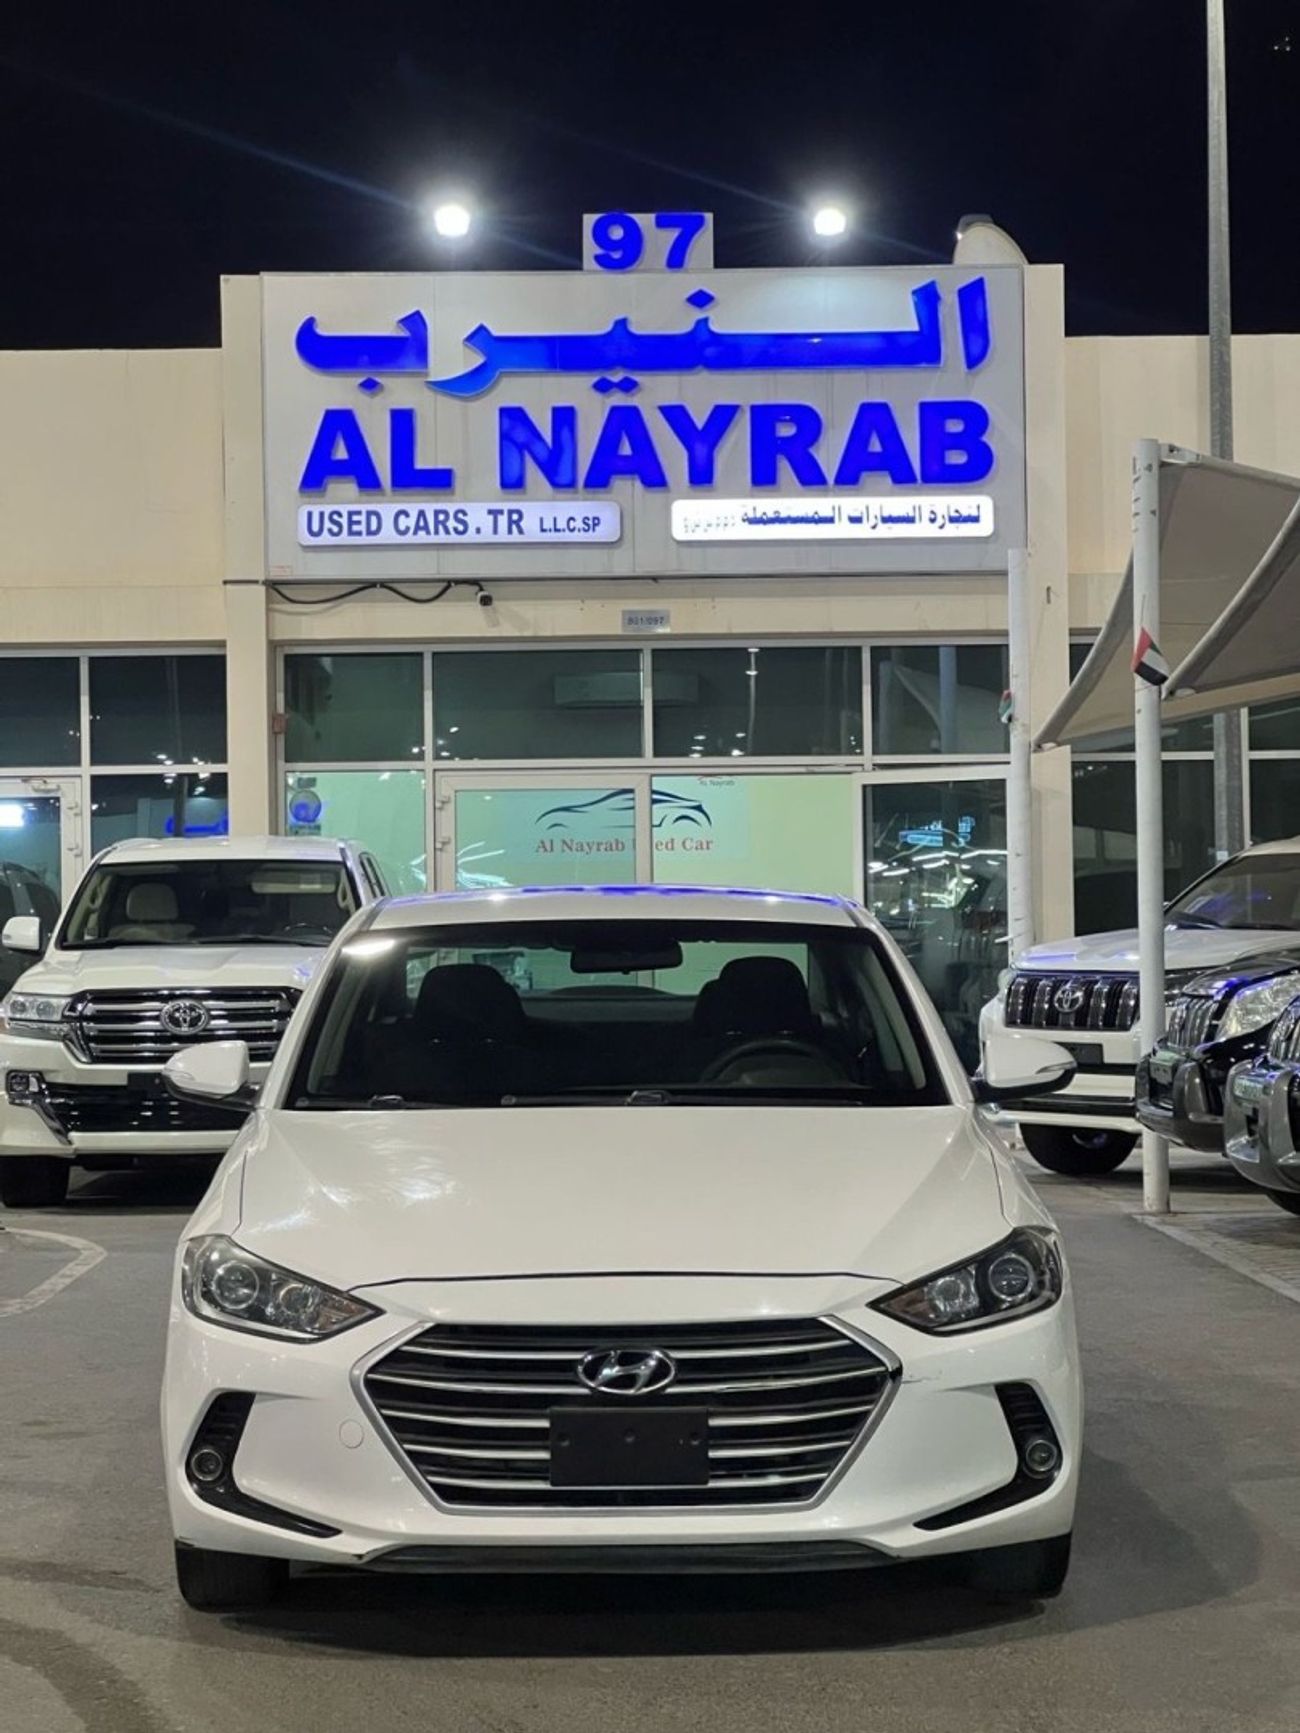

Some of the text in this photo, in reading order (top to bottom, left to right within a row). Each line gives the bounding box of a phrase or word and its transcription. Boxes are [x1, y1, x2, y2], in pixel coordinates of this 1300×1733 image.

[591, 209, 706, 271] 97
[295, 277, 991, 398] النيرب
[299, 400, 995, 494] AL NAYRAB
[306, 510, 383, 537] USED
[539, 516, 601, 533] L.L.C.SP
[847, 503, 923, 530] السيارات
[535, 839, 554, 853] Al
[561, 838, 625, 855] Nayrab
[682, 837, 713, 852] Car
